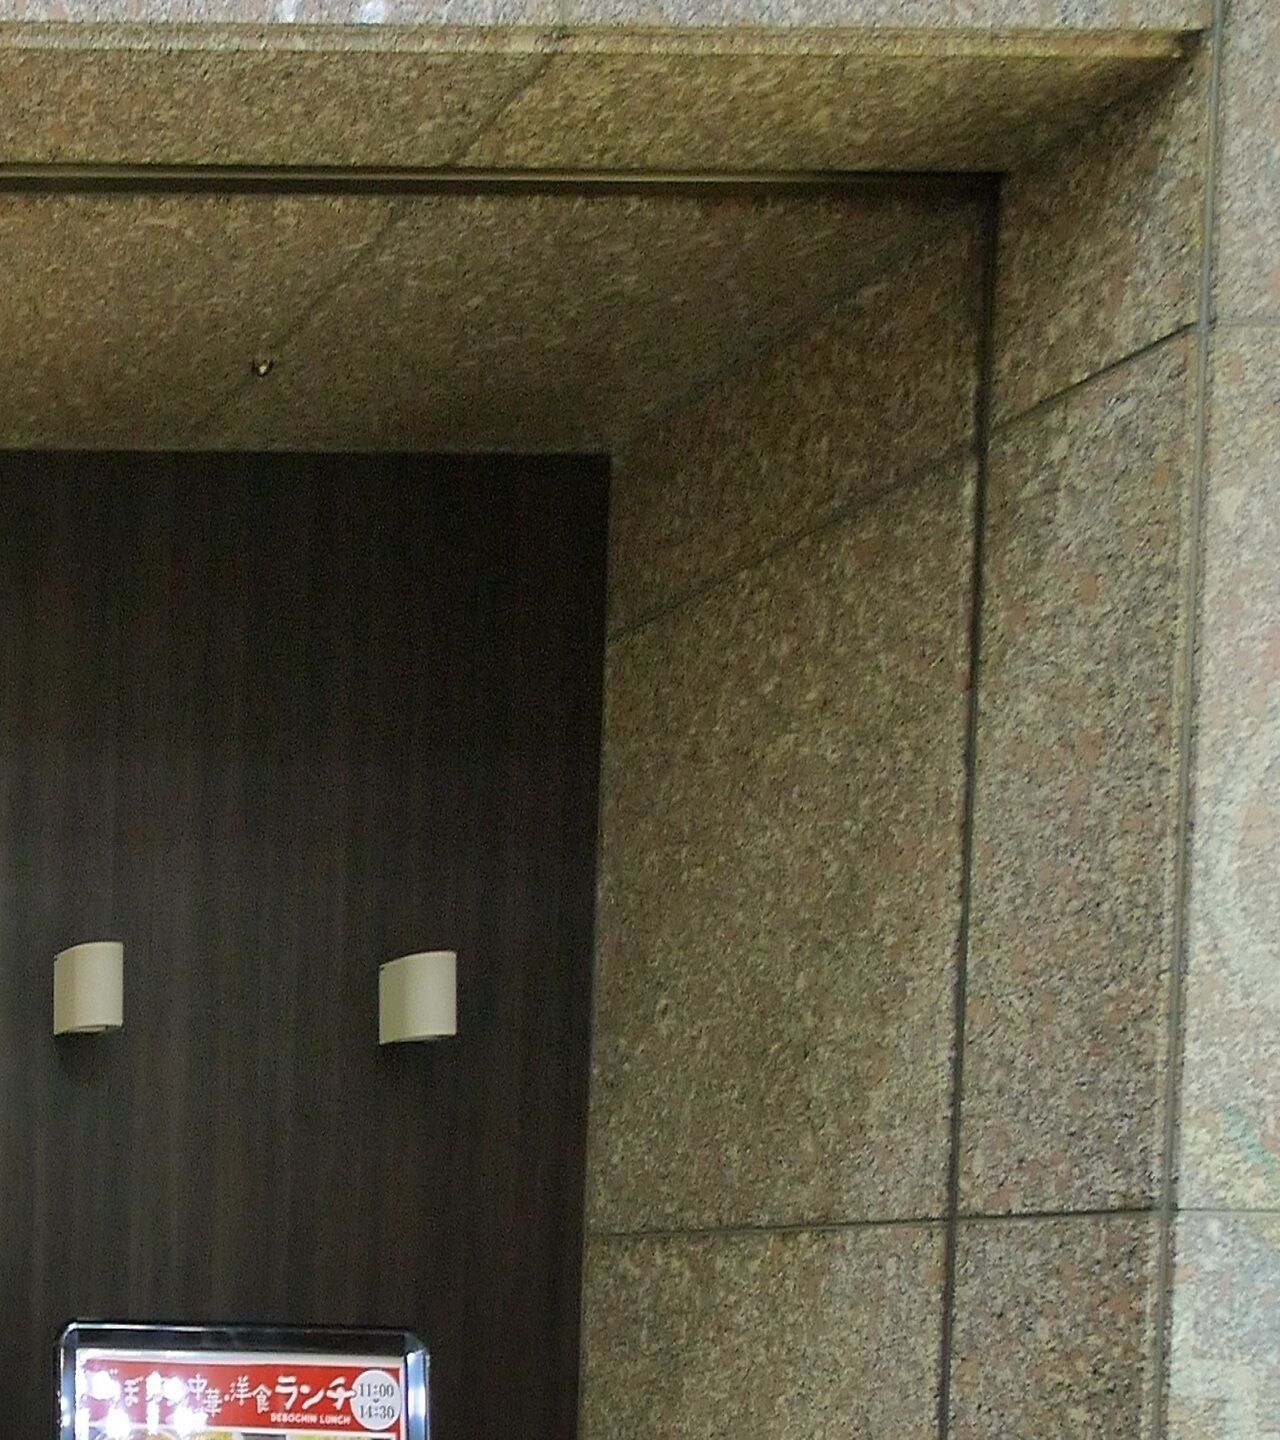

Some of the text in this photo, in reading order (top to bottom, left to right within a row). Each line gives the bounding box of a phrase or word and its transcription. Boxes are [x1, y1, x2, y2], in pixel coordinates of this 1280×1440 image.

[358, 1381, 395, 1398] 11:00
[270, 1412, 351, 1425] DEBOCHIN LUNCH
[358, 1403, 395, 1420] 14:30
